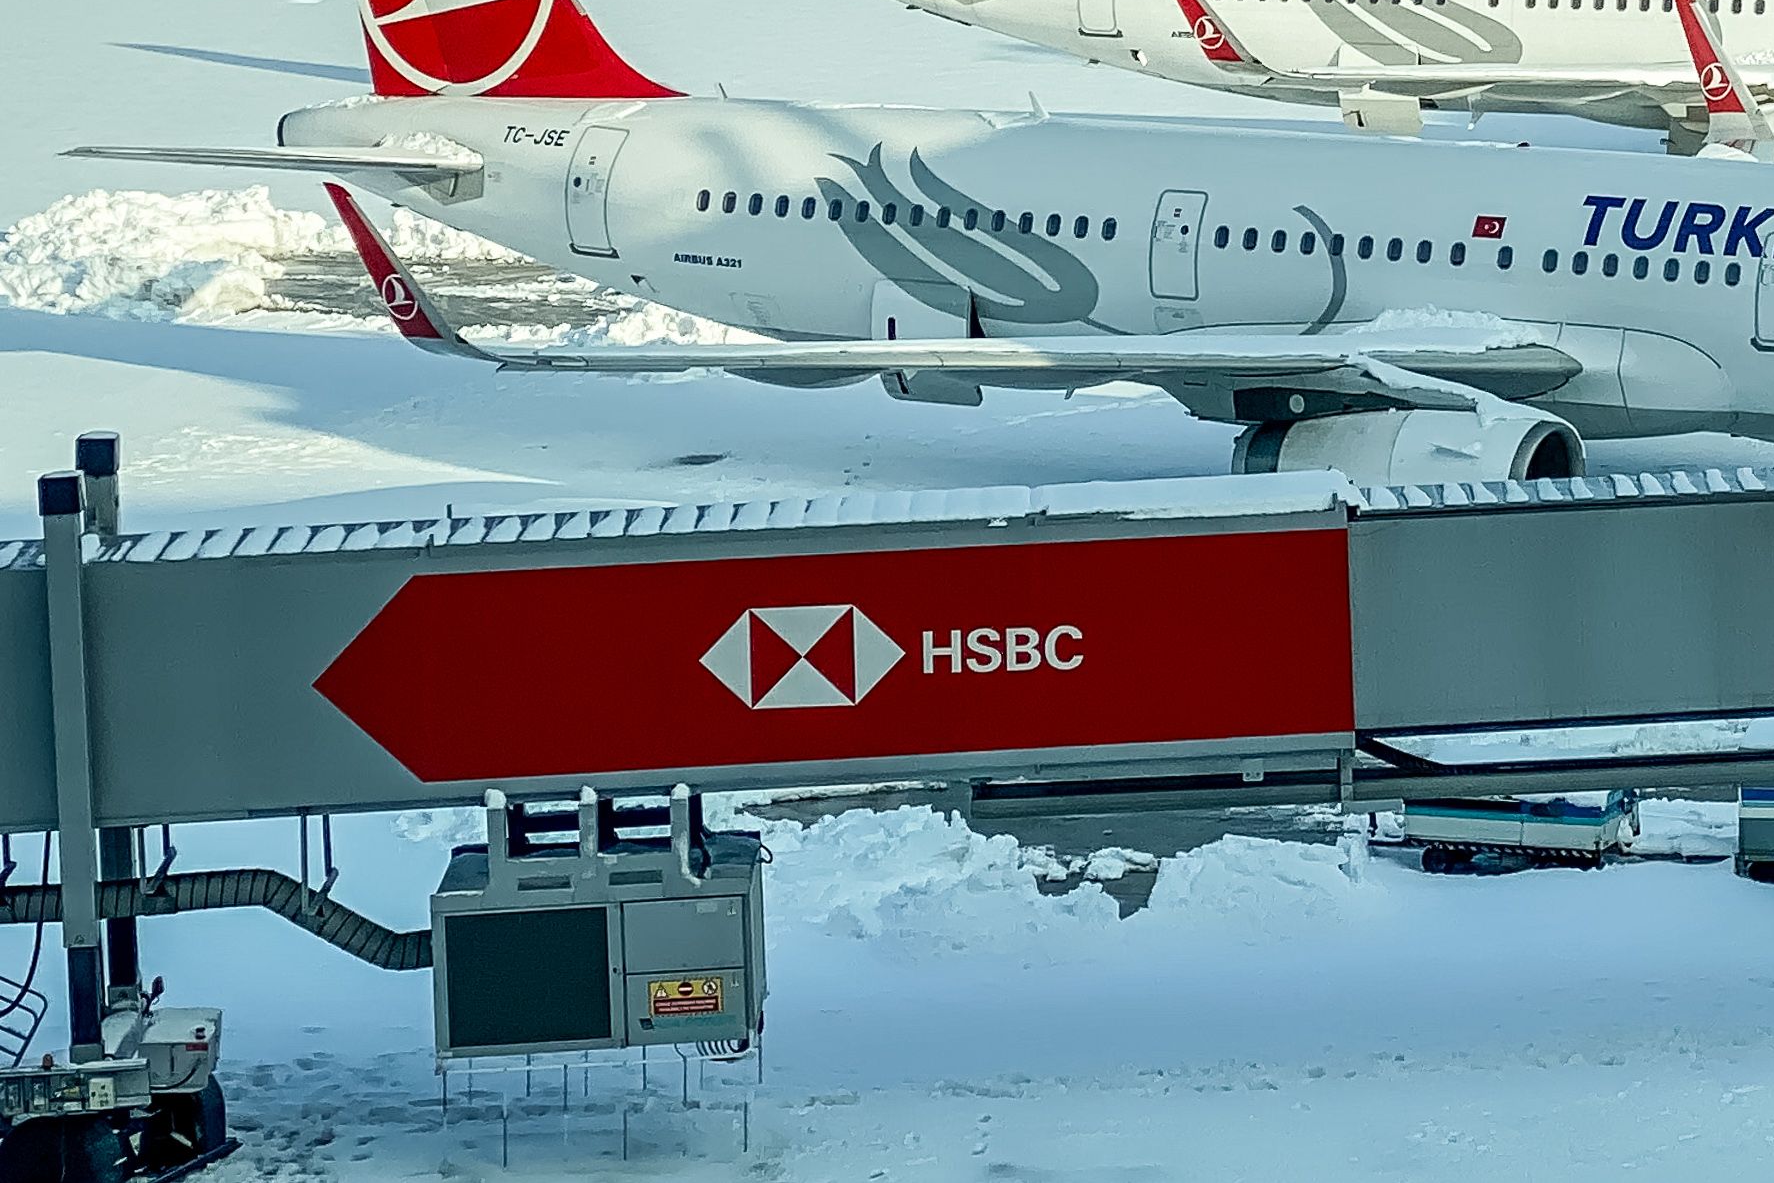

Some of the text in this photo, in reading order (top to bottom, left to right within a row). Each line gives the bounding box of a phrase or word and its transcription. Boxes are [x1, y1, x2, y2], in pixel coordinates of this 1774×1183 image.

[502, 125, 571, 148] TC-JSE
[673, 252, 742, 269] AIRBUS A321
[922, 624, 1085, 675] HSBC
